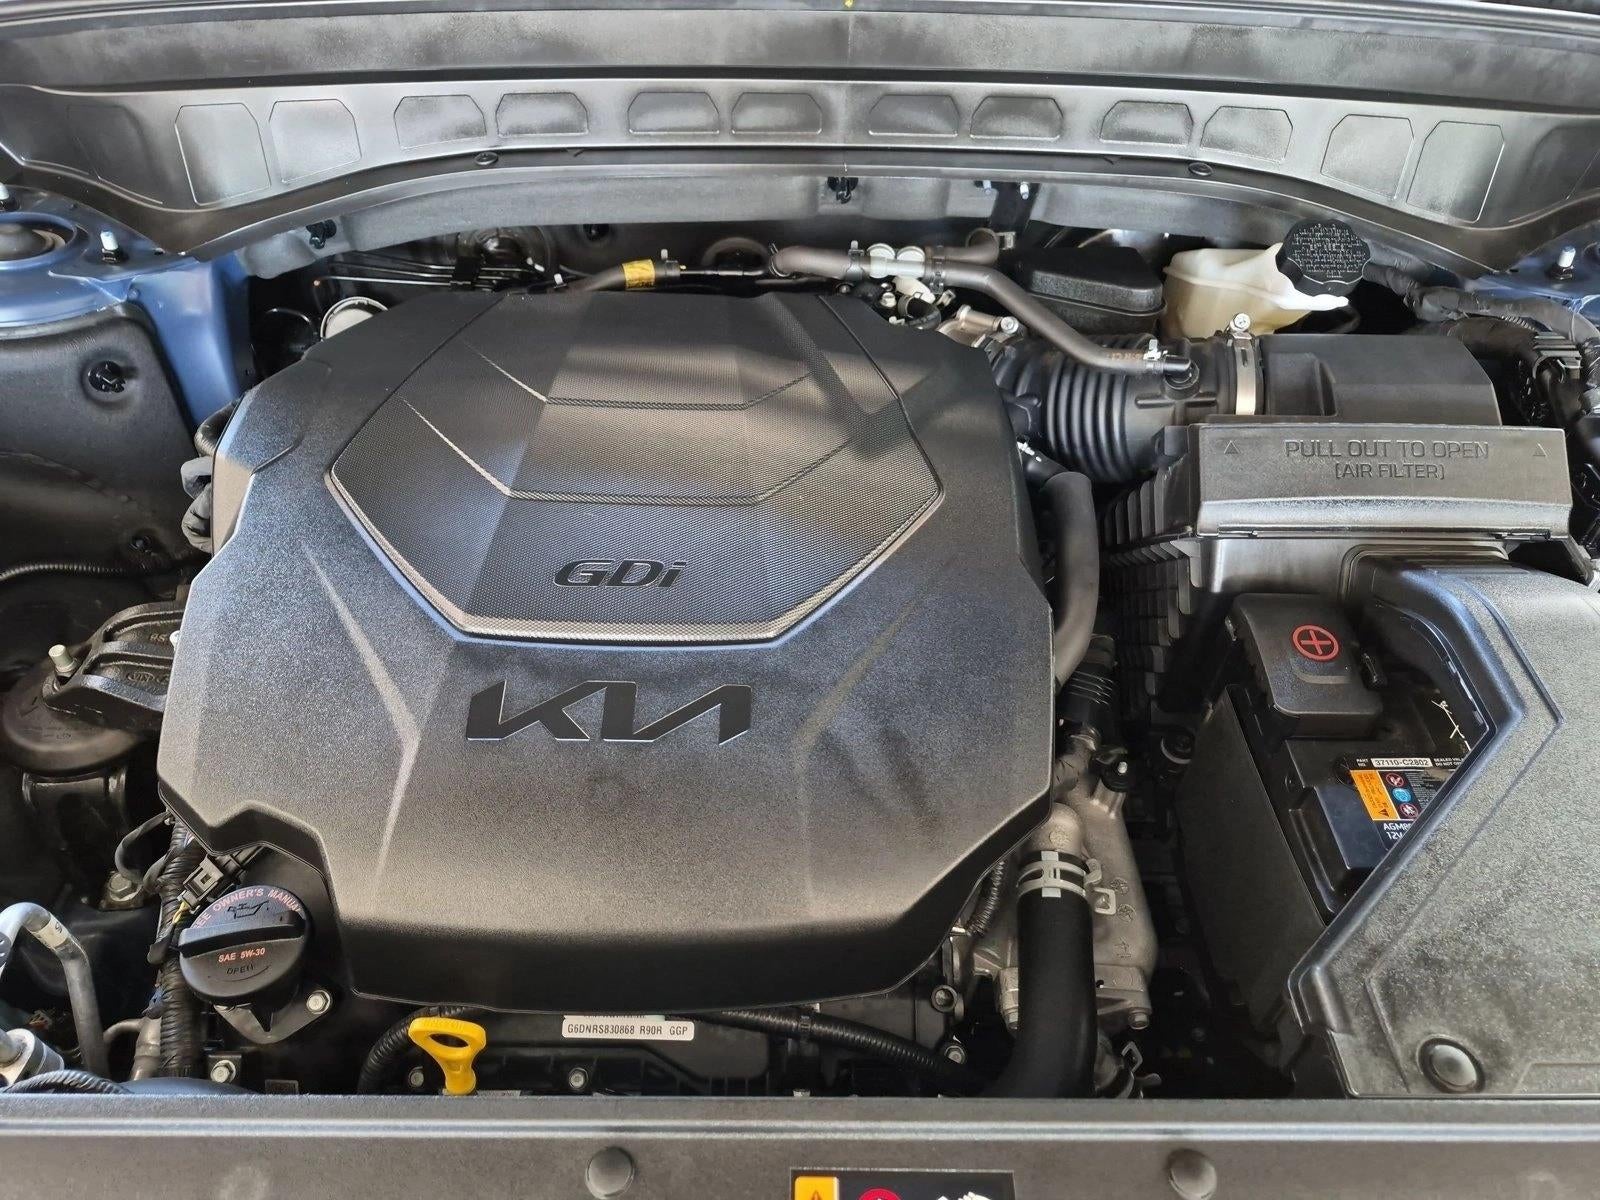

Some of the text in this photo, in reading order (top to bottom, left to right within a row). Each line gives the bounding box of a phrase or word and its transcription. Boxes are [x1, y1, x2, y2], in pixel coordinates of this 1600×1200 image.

[1284, 439, 1489, 459] PULL OUT TO OPEN
[554, 559, 687, 588] GDi
[466, 679, 752, 745] KIA
[1374, 759, 1430, 767] 37110-C2802
[213, 888, 264, 912] OWNER'S
[218, 947, 266, 962] SAE 5W-30
[226, 962, 254, 975] OPEN
[669, 1026, 688, 1036] GGP
